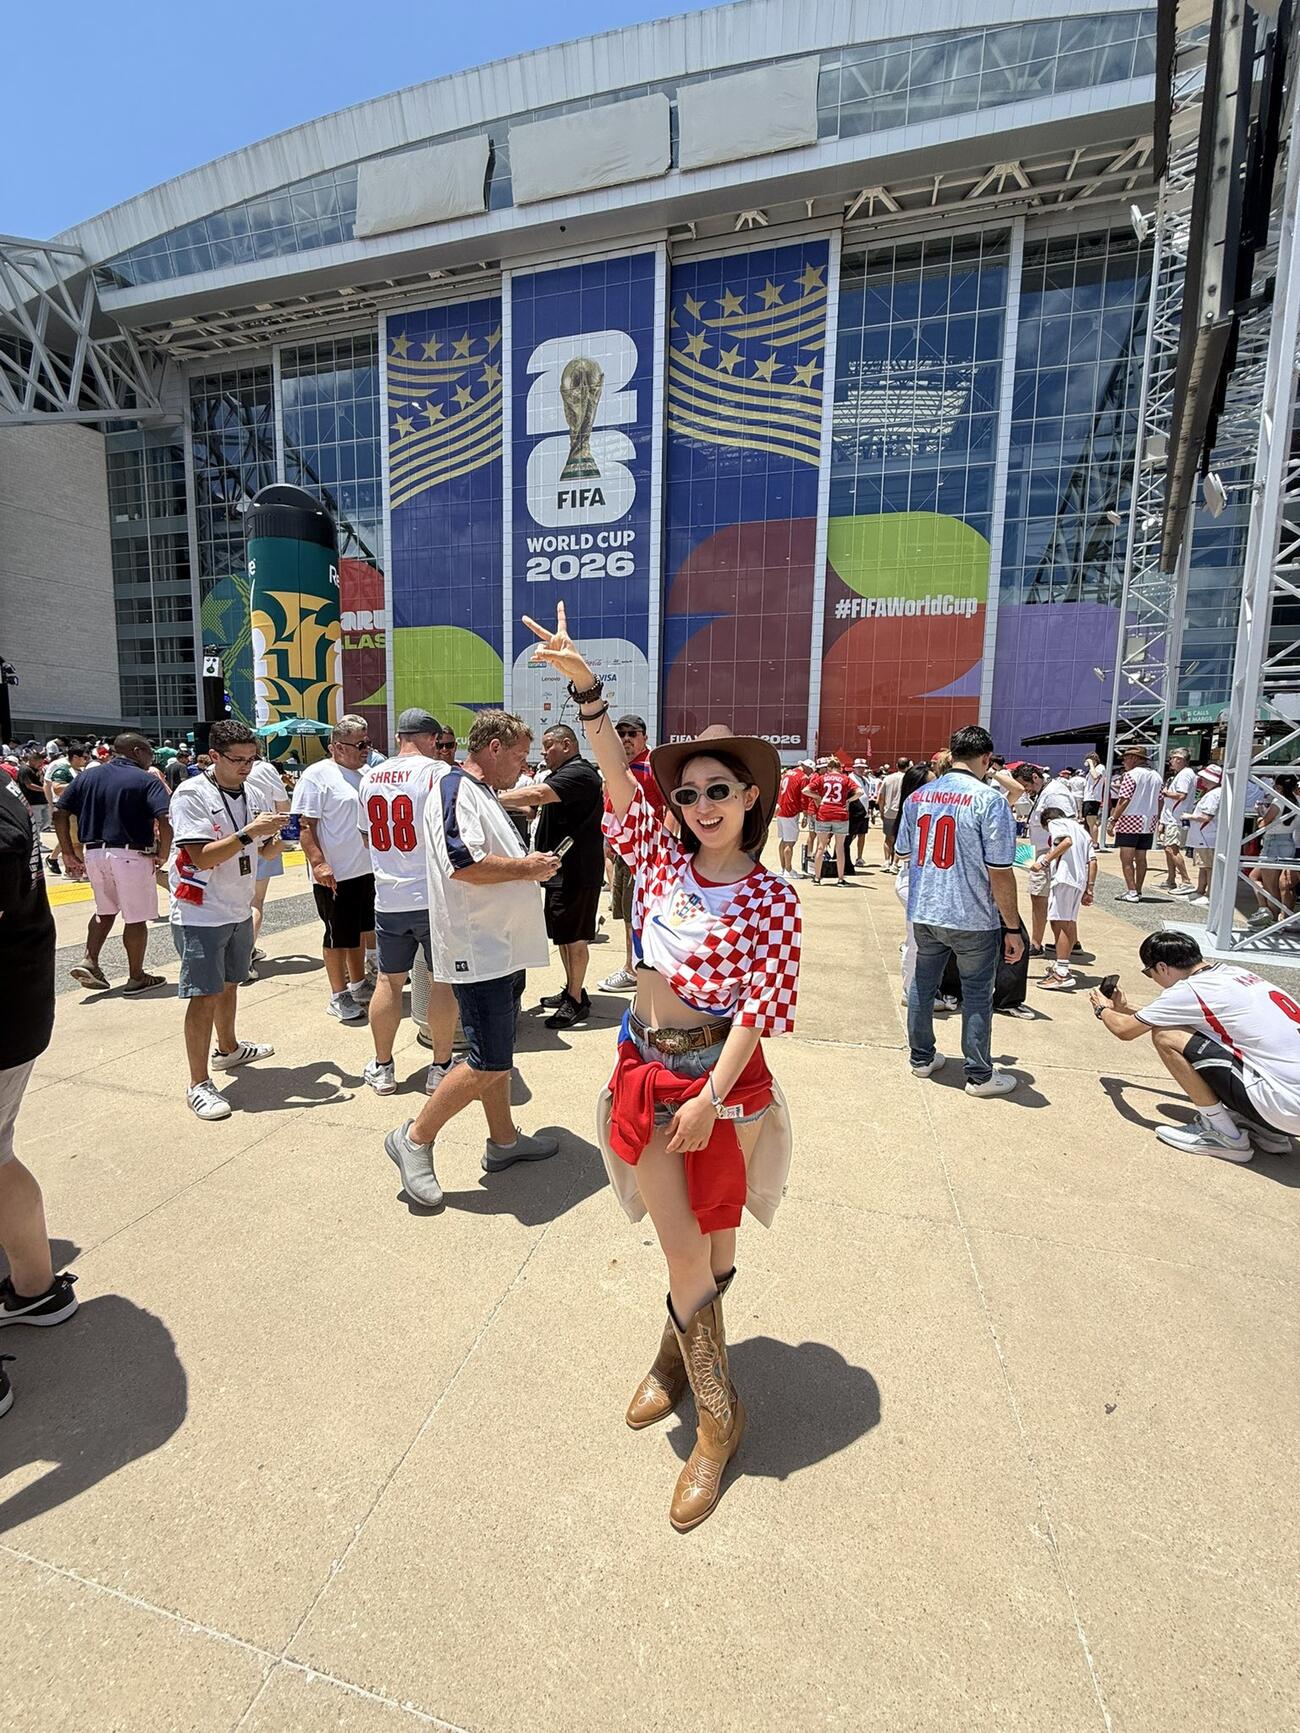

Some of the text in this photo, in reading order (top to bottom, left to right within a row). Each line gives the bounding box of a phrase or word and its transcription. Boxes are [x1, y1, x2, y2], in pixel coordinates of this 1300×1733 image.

[557, 487, 605, 510] FIFA
[526, 529, 636, 553] WORLD CUP
[526, 551, 635, 582] 2026
[834, 594, 978, 619] #FIFAWorldCup
[599, 673, 617, 682] VISA
[760, 734, 801, 744] 2026
[369, 769, 412, 784] SHREKY
[822, 782, 843, 804] 23
[367, 795, 417, 852] 88
[917, 814, 956, 870] 10
